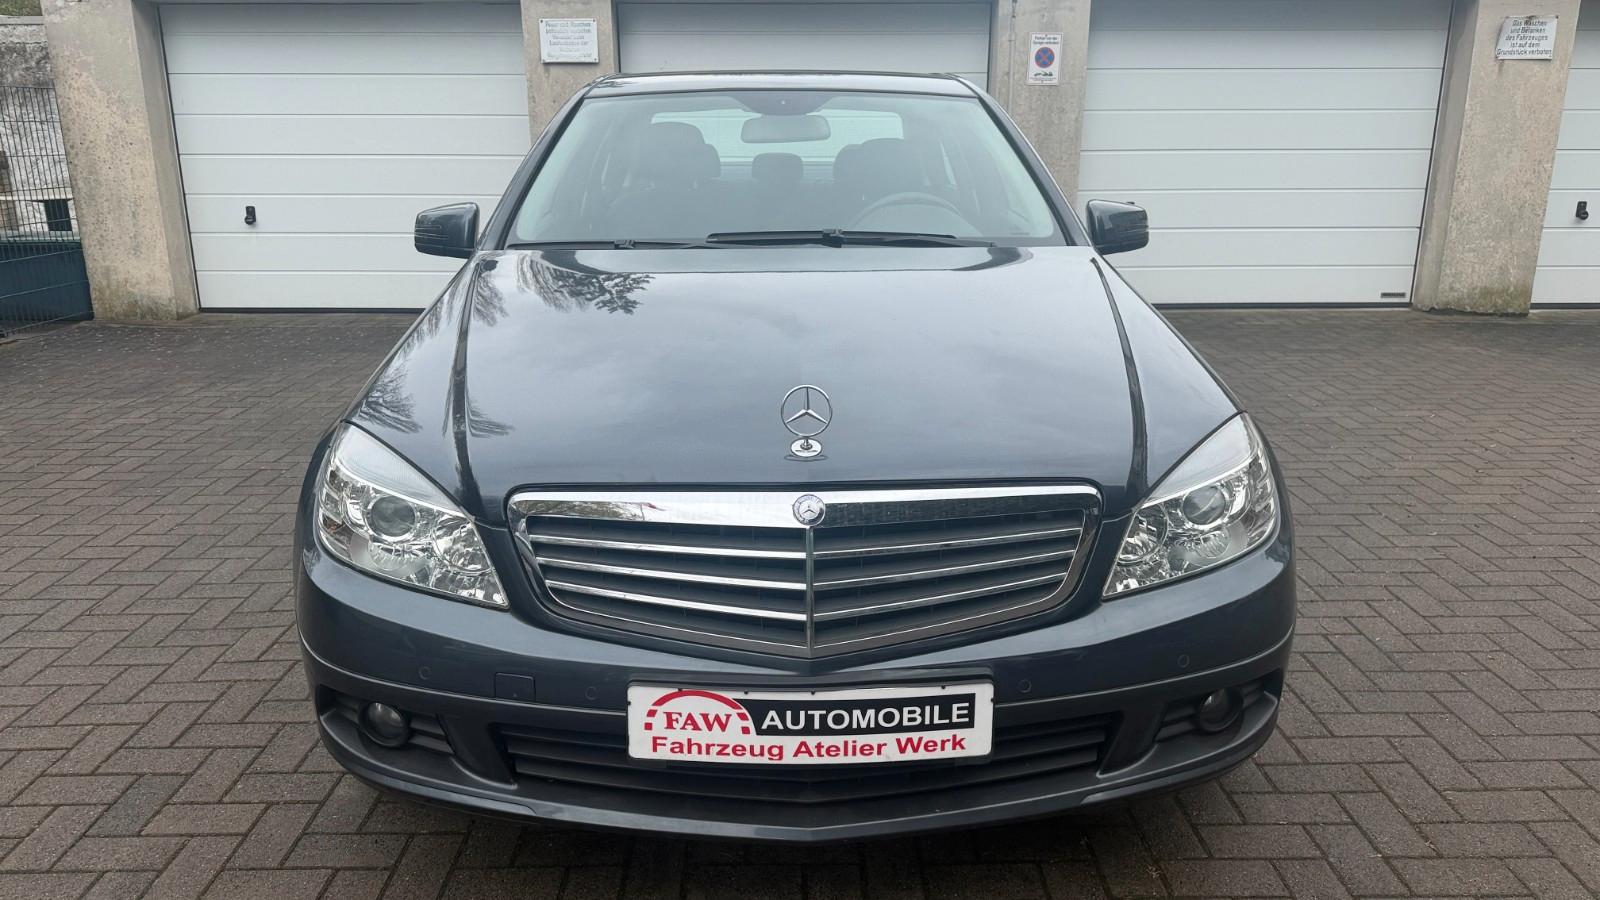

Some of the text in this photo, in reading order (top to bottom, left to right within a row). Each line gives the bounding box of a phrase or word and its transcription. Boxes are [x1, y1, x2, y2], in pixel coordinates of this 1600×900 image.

[663, 702, 970, 733] FAW AUTOMOBILE
[652, 734, 967, 761] Fahrzeug Atelier Werk
